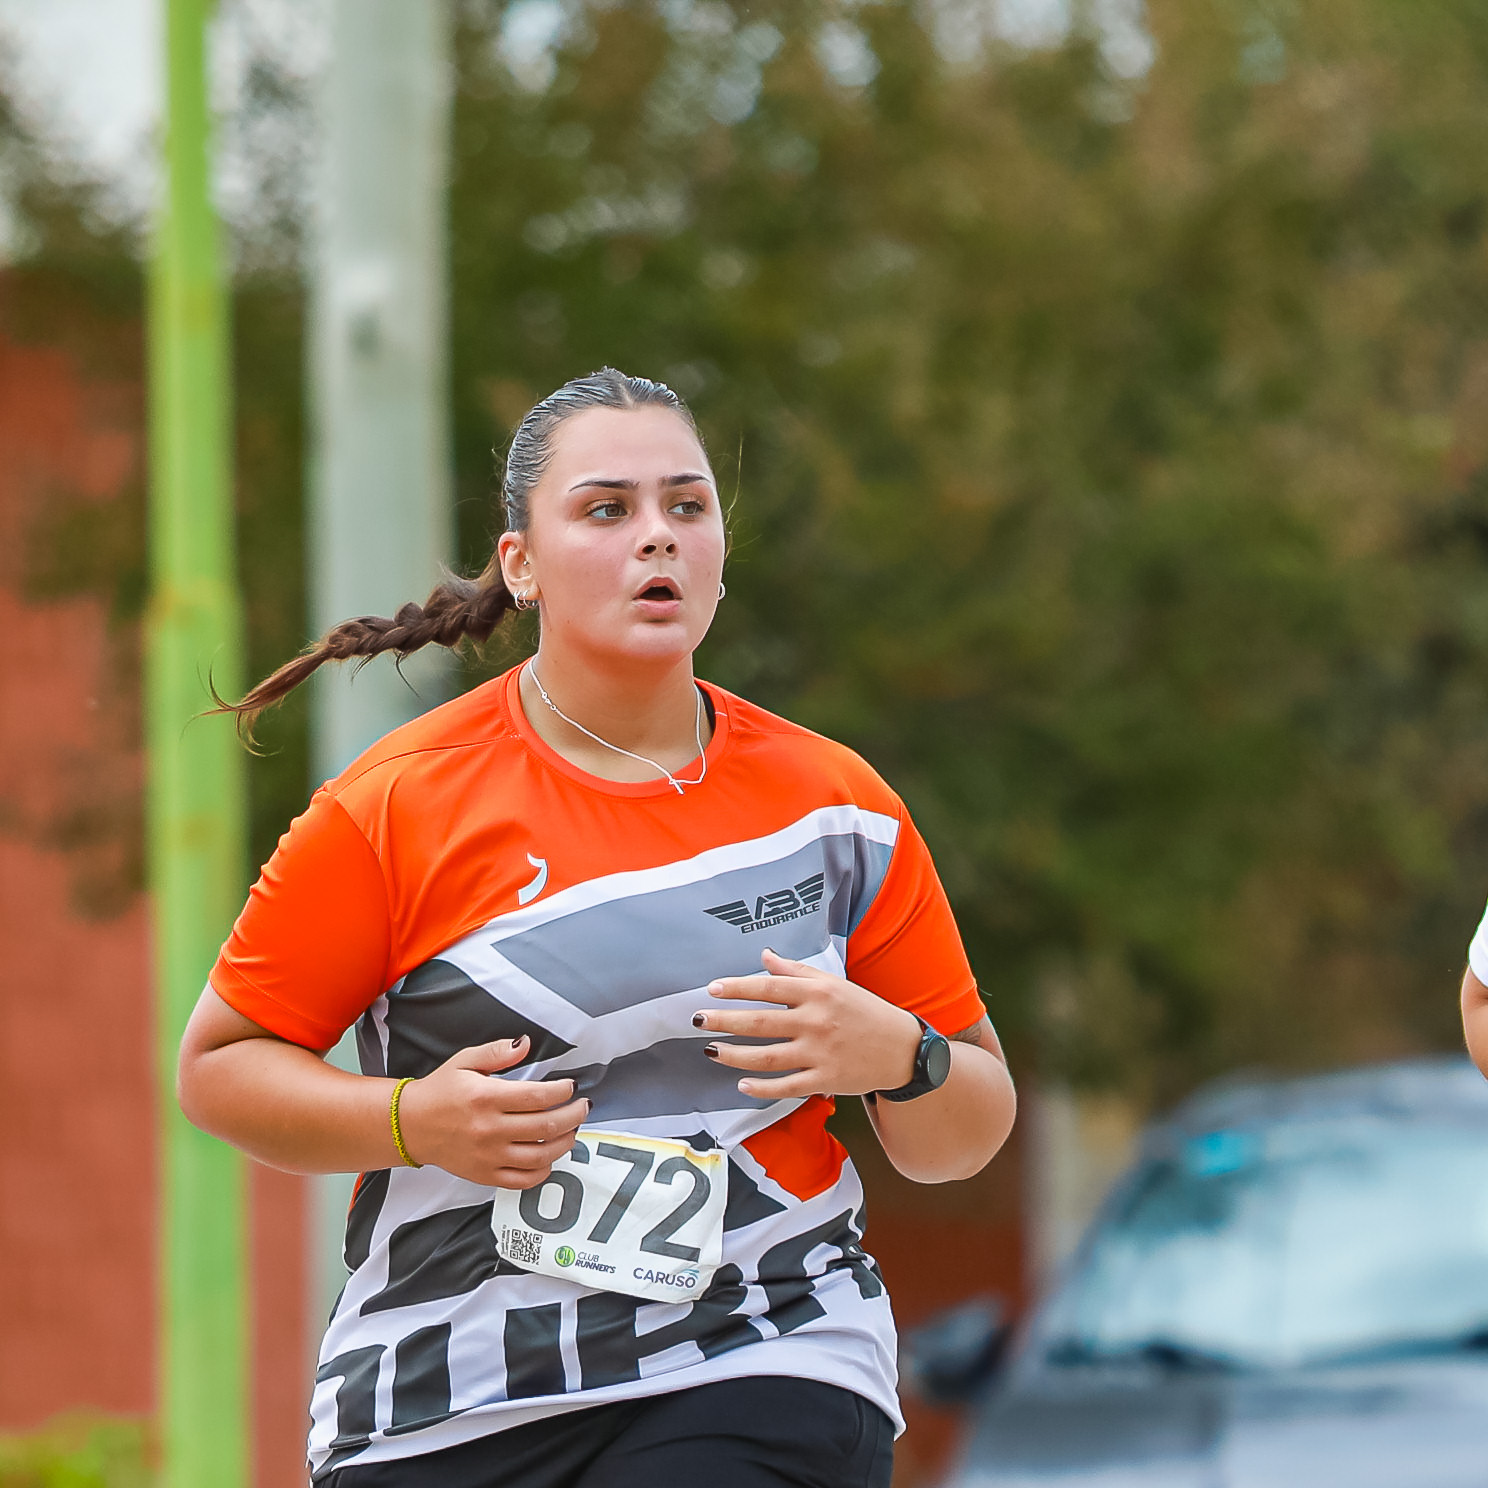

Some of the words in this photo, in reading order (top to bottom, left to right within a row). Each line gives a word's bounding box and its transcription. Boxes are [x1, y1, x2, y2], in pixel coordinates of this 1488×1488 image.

[740, 902, 821, 934] ENDURANCE
[519, 1140, 711, 1264] 672
[574, 1259, 617, 1274] RUNNER'S
[577, 1251, 600, 1263] CLUB
[632, 1267, 697, 1289] CARUSO
